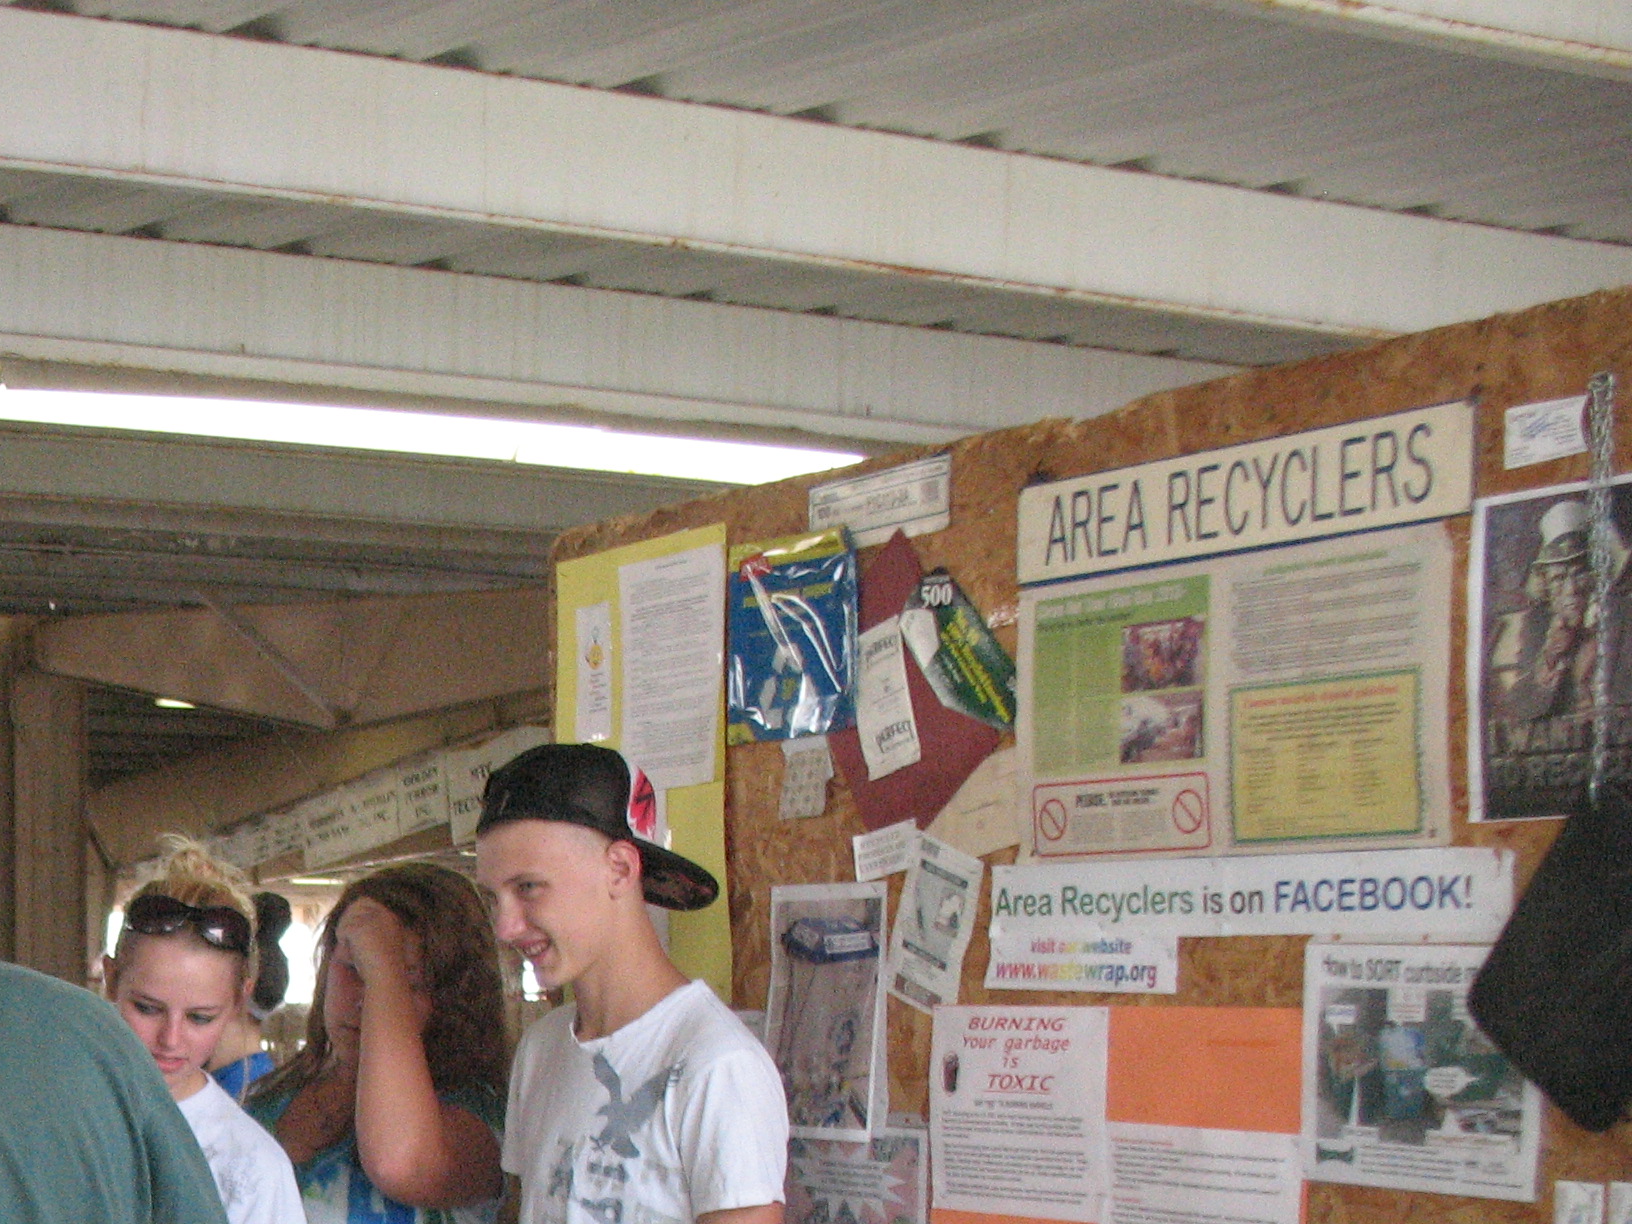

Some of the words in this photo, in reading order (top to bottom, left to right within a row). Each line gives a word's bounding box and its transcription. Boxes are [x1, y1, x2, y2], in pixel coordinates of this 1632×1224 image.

[1045, 480, 1148, 566] AREA
[1167, 423, 1435, 545] RECYCLERS
[921, 584, 953, 608] 500
[995, 887, 1052, 917] Area
[1060, 885, 1195, 923] Recyclers
[1202, 886, 1224, 915] is
[1229, 890, 1264, 915] on
[1274, 875, 1473, 913] FACEBOOK!
[1031, 938, 1056, 953] visit
[1082, 938, 1133, 954] website
[995, 961, 1158, 989] www.wastewrap.org
[968, 1016, 1069, 1032] BURNING
[1003, 1035, 1071, 1055] garbage
[986, 1073, 1056, 1093] TOXIC
